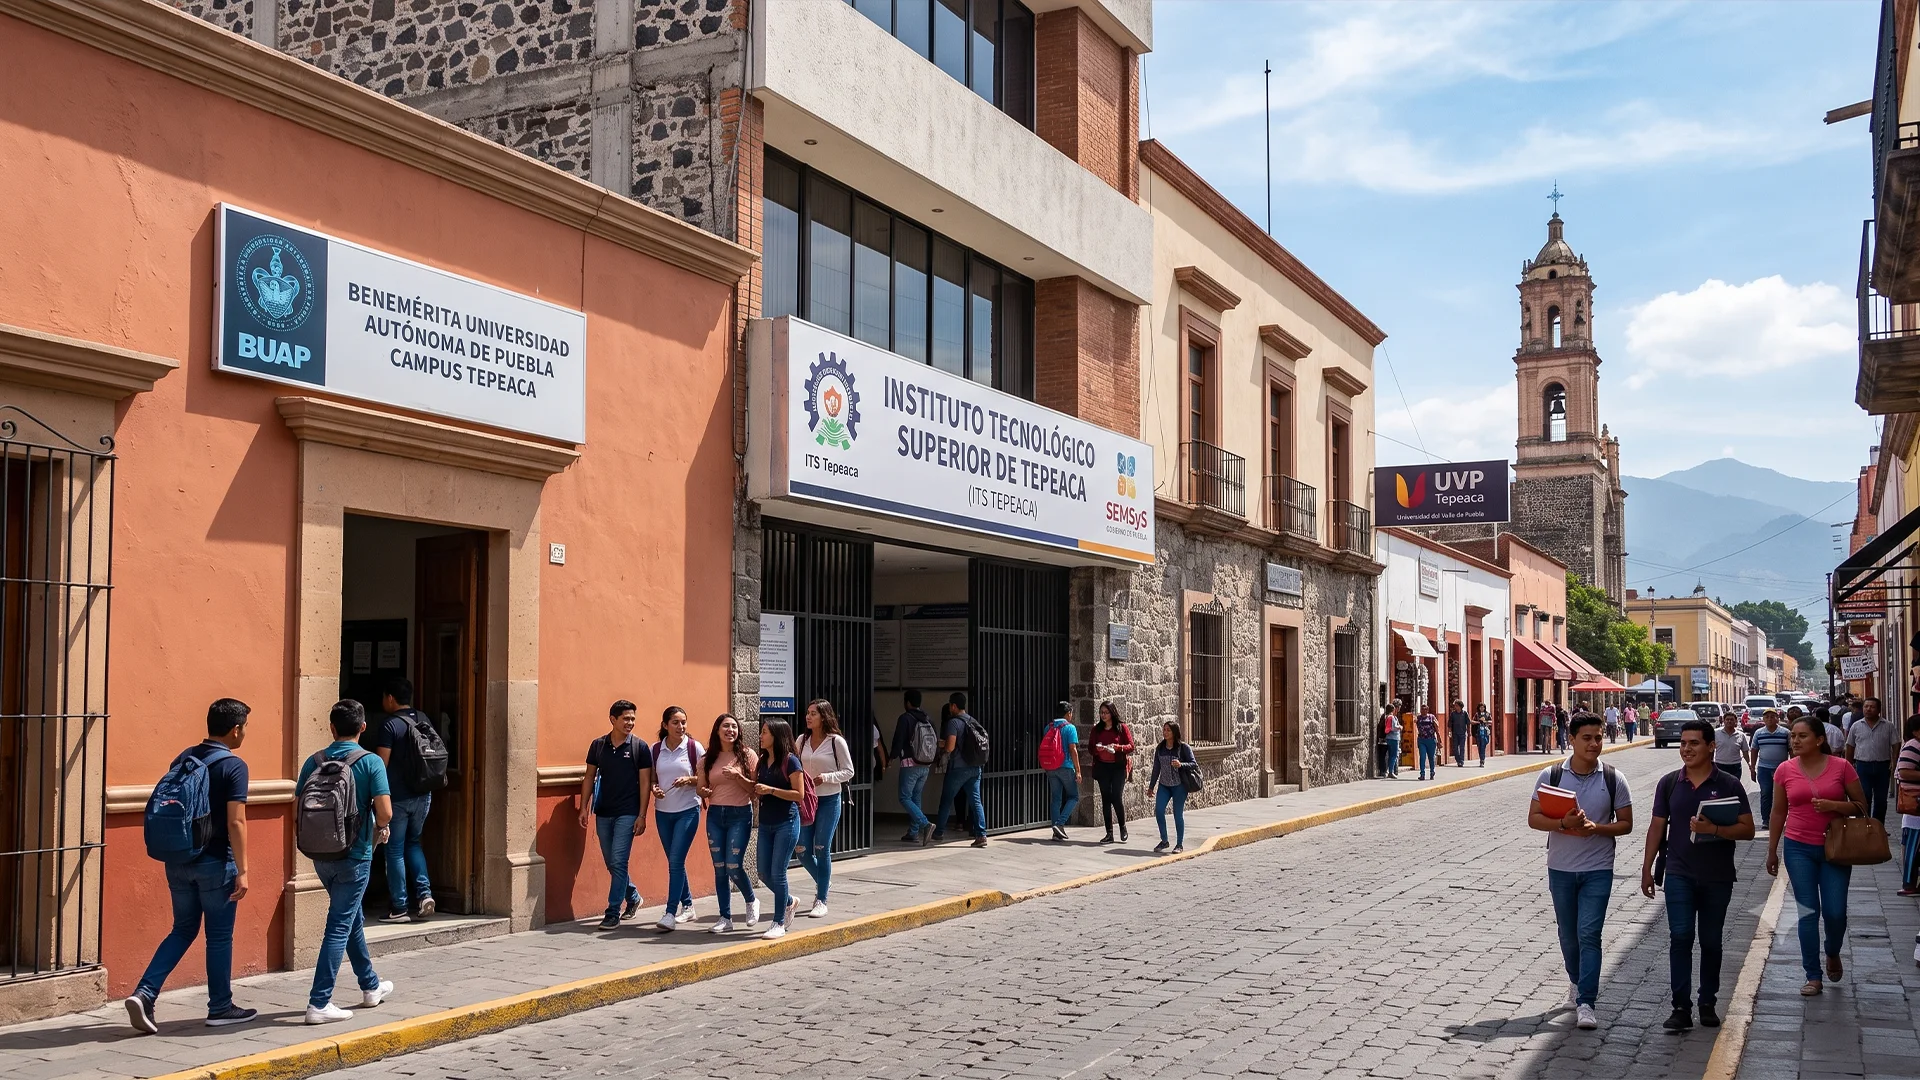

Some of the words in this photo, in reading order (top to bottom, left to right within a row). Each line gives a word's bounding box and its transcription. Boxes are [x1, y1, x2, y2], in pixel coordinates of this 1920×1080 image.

[348, 281, 462, 330] BENEMÉRITA
[466, 314, 570, 358] UNIVERSIDAD
[238, 331, 311, 369] BUAP
[364, 314, 466, 357] AUTÓNOMA
[470, 342, 490, 363] DE
[495, 348, 554, 379] PUEBLA
[390, 348, 462, 381] CAMPUS
[467, 366, 537, 399] TEPEACA
[884, 375, 984, 436] INSTITUTO
[988, 409, 1095, 469] TECNOLÓGICO
[805, 453, 820, 469] ITS
[822, 457, 859, 478] Tepeaca
[897, 425, 991, 479] SUPERIOR
[996, 452, 1017, 485] DE
[1020, 458, 1087, 502] TEPEACA
[1434, 470, 1485, 491] UVP
[968, 485, 988, 508] (ITS
[991, 490, 1038, 521] TEPEACA)
[1106, 501, 1148, 531] SEMSyS
[1396, 513, 1430, 521] Universidad
[1434, 493, 1485, 506] Tepeaca
